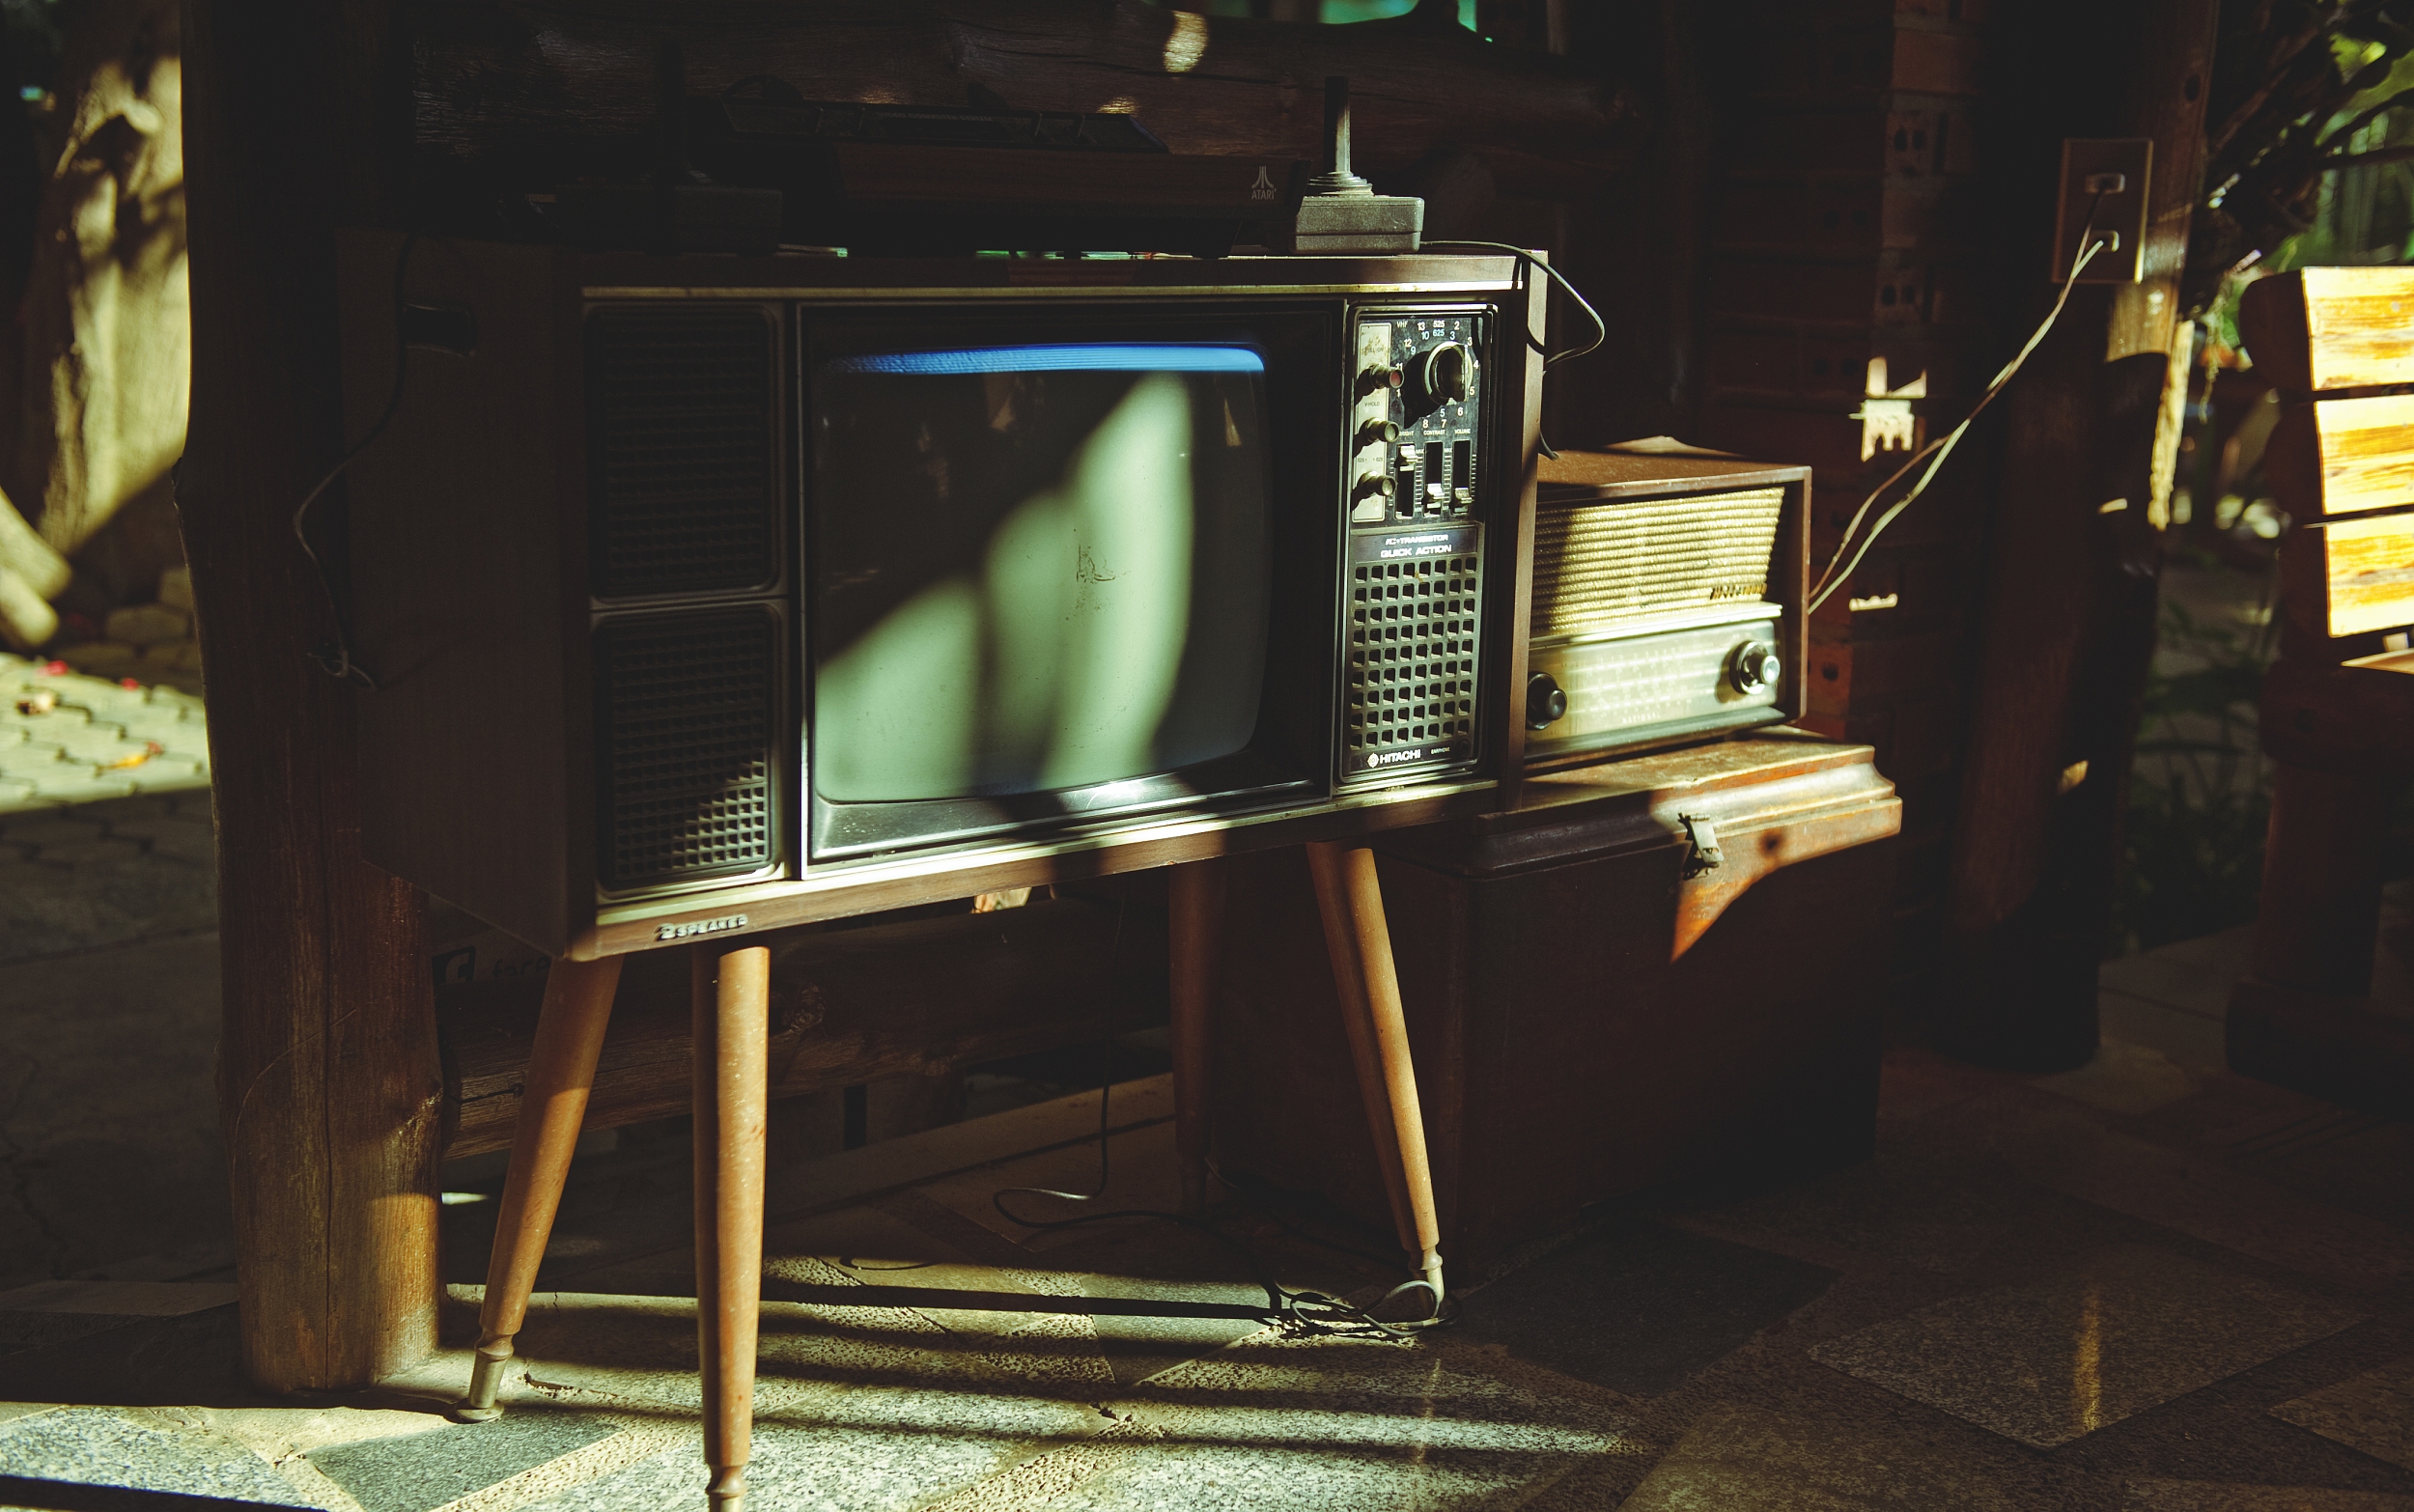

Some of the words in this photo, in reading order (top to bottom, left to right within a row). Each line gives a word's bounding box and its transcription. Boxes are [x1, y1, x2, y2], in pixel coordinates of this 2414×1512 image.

[1250, 188, 1275, 200] ATARI
[1417, 322, 1426, 331] 13
[1432, 320, 1446, 328] 525
[1454, 321, 1460, 330] 2
[1420, 330, 1430, 340] 10
[1432, 328, 1446, 337] 625
[1449, 331, 1455, 340] 3
[1404, 338, 1413, 348] 12
[1467, 337, 1473, 347] 3
[1410, 346, 1417, 355] 9
[1473, 359, 1479, 370] 4
[1469, 386, 1475, 396] 5
[1440, 408, 1446, 418] 5
[1457, 406, 1464, 416] 6
[1422, 419, 1429, 429] 8
[1441, 419, 1446, 428] 7
[1380, 547, 1413, 558] QUICK
[1416, 544, 1452, 556] ACTION
[1379, 748, 1421, 765] HITACHI
